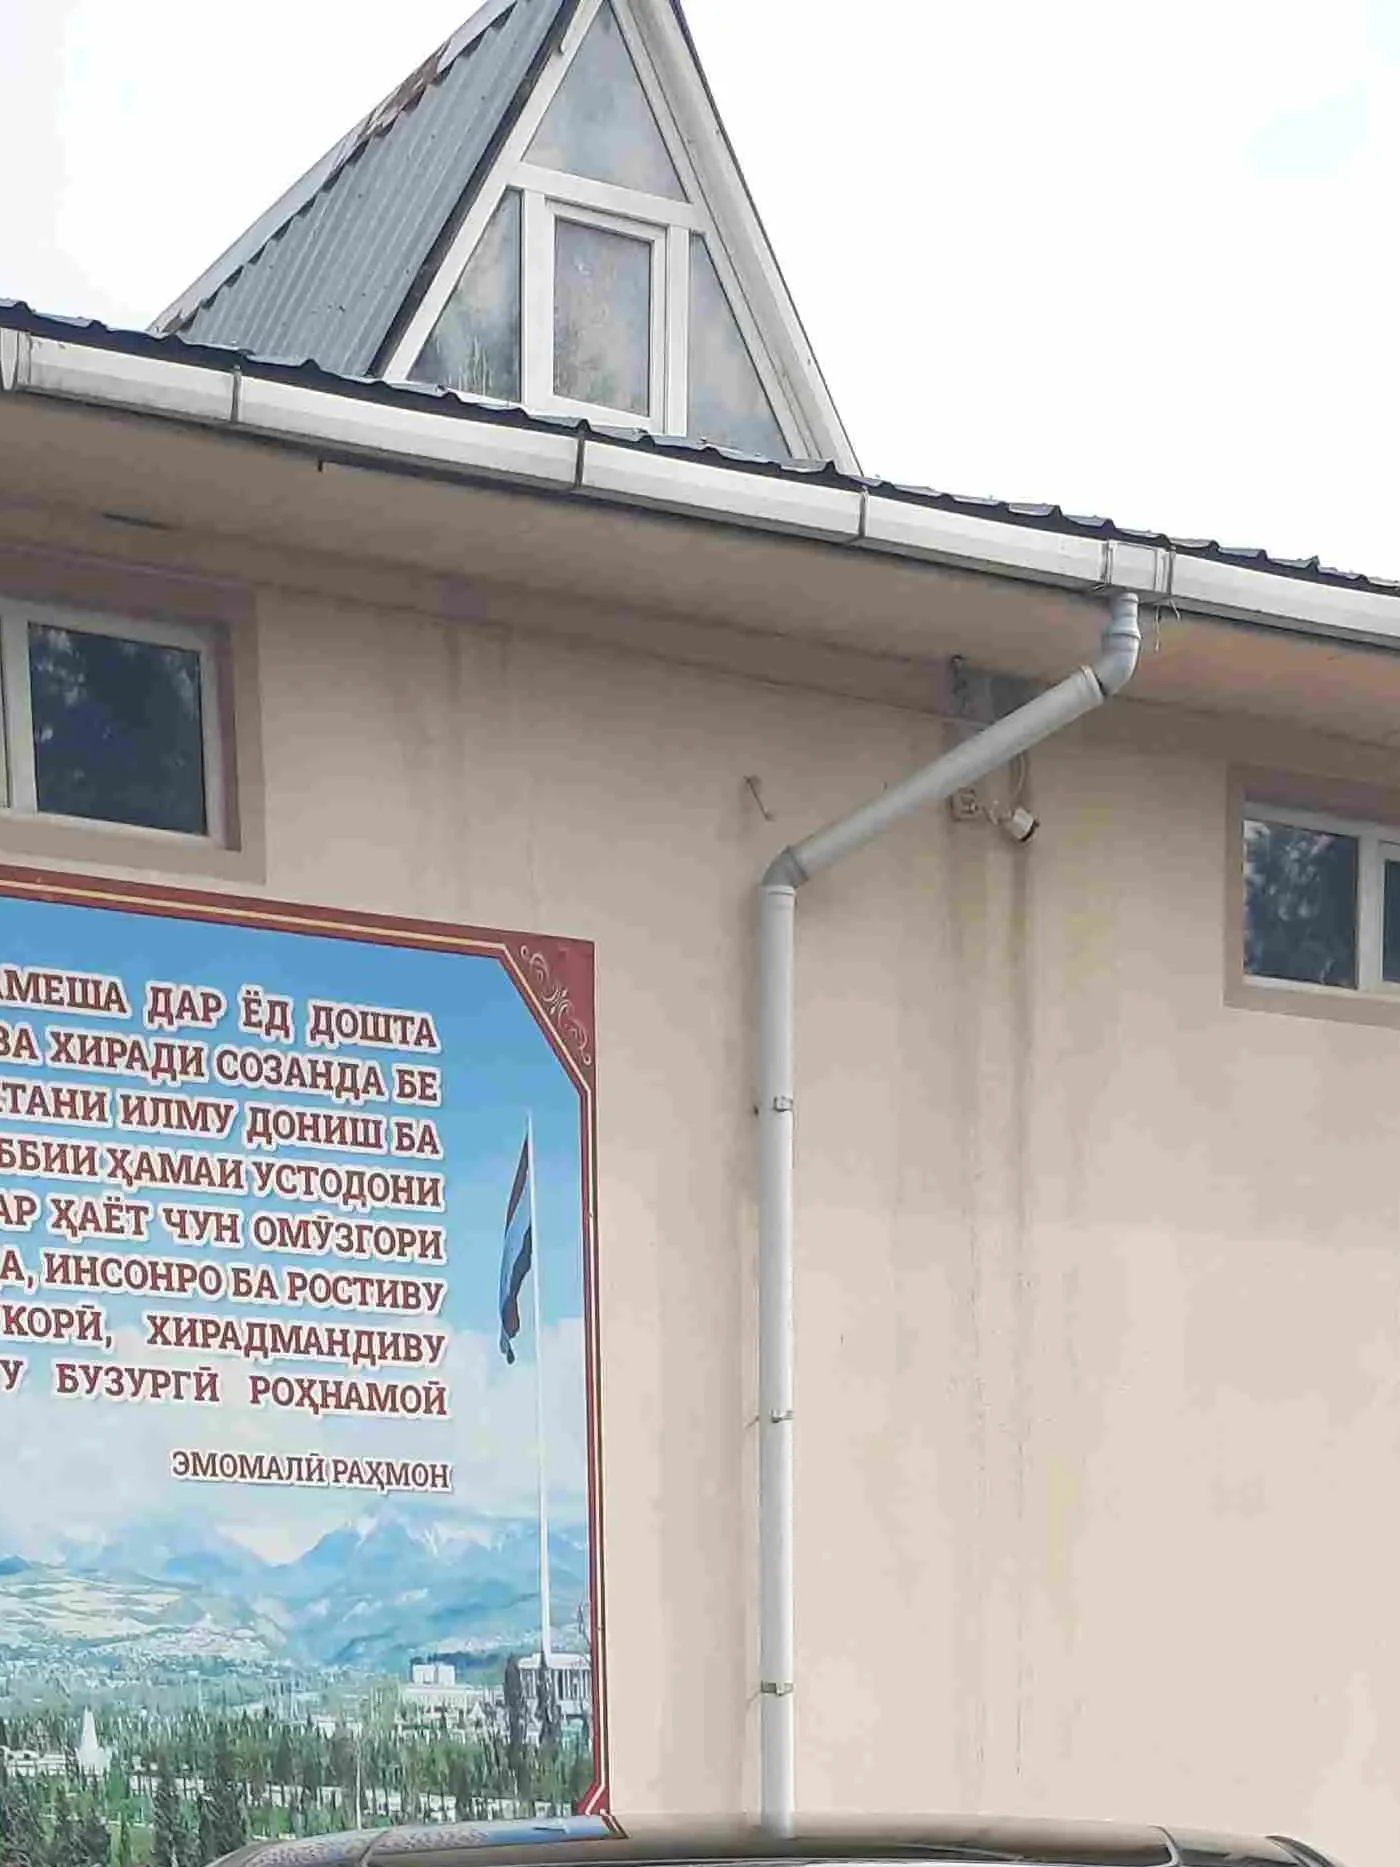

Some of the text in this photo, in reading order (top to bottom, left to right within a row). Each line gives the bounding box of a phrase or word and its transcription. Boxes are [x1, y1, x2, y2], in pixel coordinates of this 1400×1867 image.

[148, 985, 222, 1026] ДАР
[244, 989, 290, 1039] ЁД
[309, 1004, 436, 1048] ДОШТА
[49, 1031, 204, 1081] ХИРАДИ
[215, 1049, 384, 1101] СОЗАНДА
[396, 1068, 436, 1102] БЕ
[121, 1095, 235, 1134] ИЛМУ
[246, 1106, 384, 1150] ДОНИШ
[395, 1121, 440, 1155] БА
[106, 1147, 245, 1190] ҲАМАИ
[254, 1163, 441, 1206] УСТОДОНИ
[52, 1195, 149, 1238] ҲАЁТ
[163, 1207, 240, 1244] ЧУН
[253, 1215, 442, 1260] ОМӮЗГОРИ
[45, 1252, 223, 1296] ИНСОНРО
[232, 1270, 279, 1300] БА
[286, 1271, 442, 1312] РОСТИВУ
[149, 1315, 446, 1367] ХИРАДМАНДИВУ
[55, 1363, 220, 1402] БУЗУРГӢ
[249, 1375, 447, 1416] РОҲНАМОӢ
[172, 1451, 447, 1489] ЭМОМАЛӢ РАҲМОН
